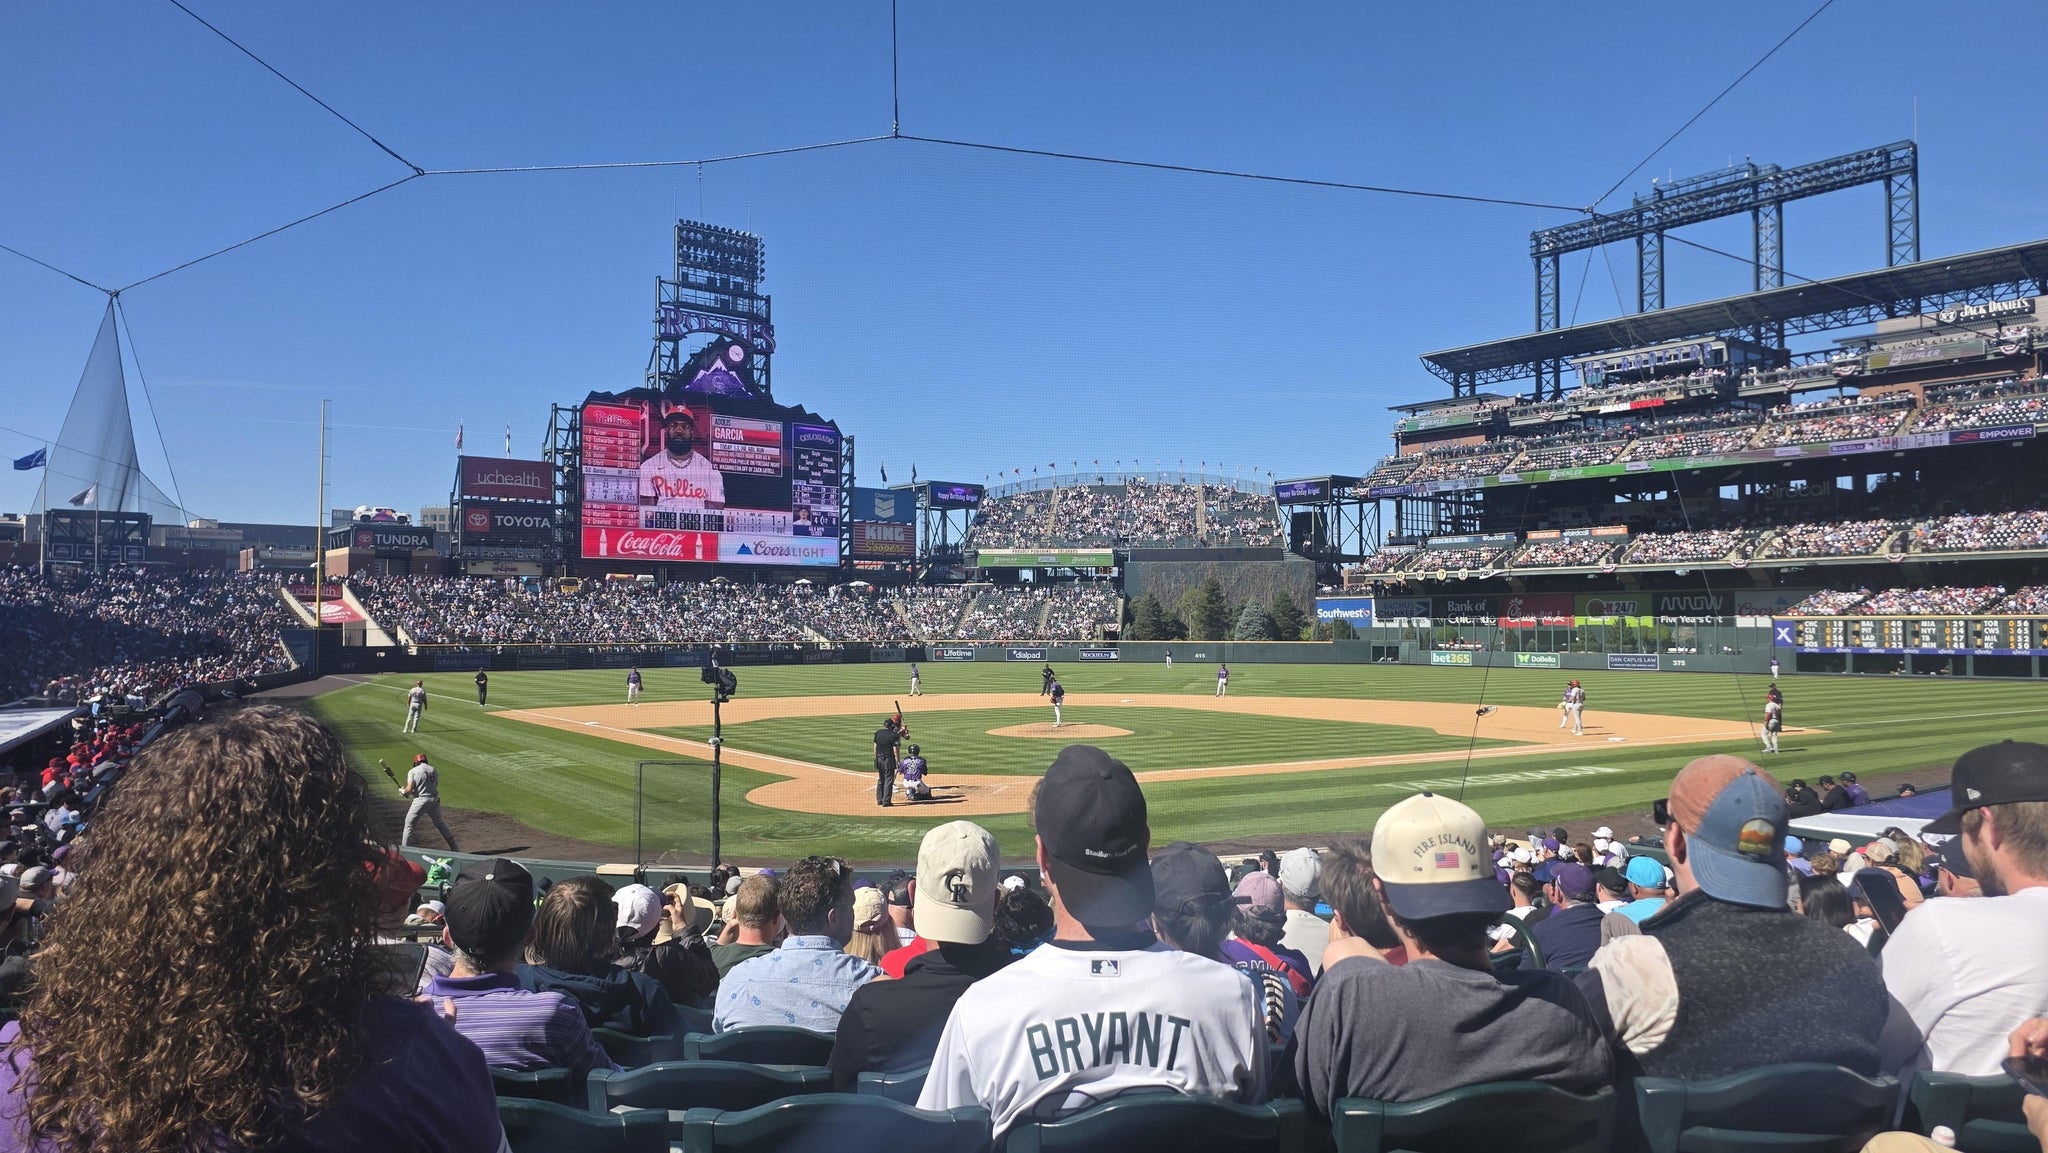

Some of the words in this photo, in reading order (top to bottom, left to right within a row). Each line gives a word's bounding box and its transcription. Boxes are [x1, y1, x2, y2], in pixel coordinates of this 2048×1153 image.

[1960, 305, 1987, 317] JACK
[660, 309, 777, 353] ROCKIES
[1573, 359, 1607, 379] THE
[1621, 342, 1713, 372] ROOFTOP
[1890, 349, 1941, 366] BUEHLER
[1599, 402, 1630, 414] SMASH
[714, 427, 744, 441] GARCIA
[800, 433, 835, 444] COLORADO
[1980, 427, 2033, 439] EMPOWER
[478, 469, 541, 487] uchealth
[1549, 469, 1583, 480] BUEHLER
[651, 475, 707, 498] Phillies
[950, 492, 965, 501] Birthday
[495, 515, 551, 528] TOYOTA
[865, 525, 905, 540] KING
[375, 533, 429, 545] TUNDRA
[617, 531, 685, 556] Coca-Cola
[754, 540, 790, 556] Coors
[791, 547, 825, 557] LIGHT
[865, 540, 905, 553] Soopers
[292, 585, 336, 596] uchelth
[1448, 600, 1471, 612] Bank
[1475, 599, 1487, 611] of
[1615, 602, 1637, 613] 24/7
[1317, 608, 1364, 618] Southwest
[1448, 612, 1497, 624] Colorado
[1015, 651, 1041, 660] dialpad
[1433, 653, 1470, 663] bet365
[1531, 655, 1556, 663] DaBella
[1414, 837, 1437, 858] FIRE
[1438, 834, 1476, 855] ISLAND
[1085, 849, 1114, 858] Stadium
[1026, 1011, 1190, 1081] BRYANT
